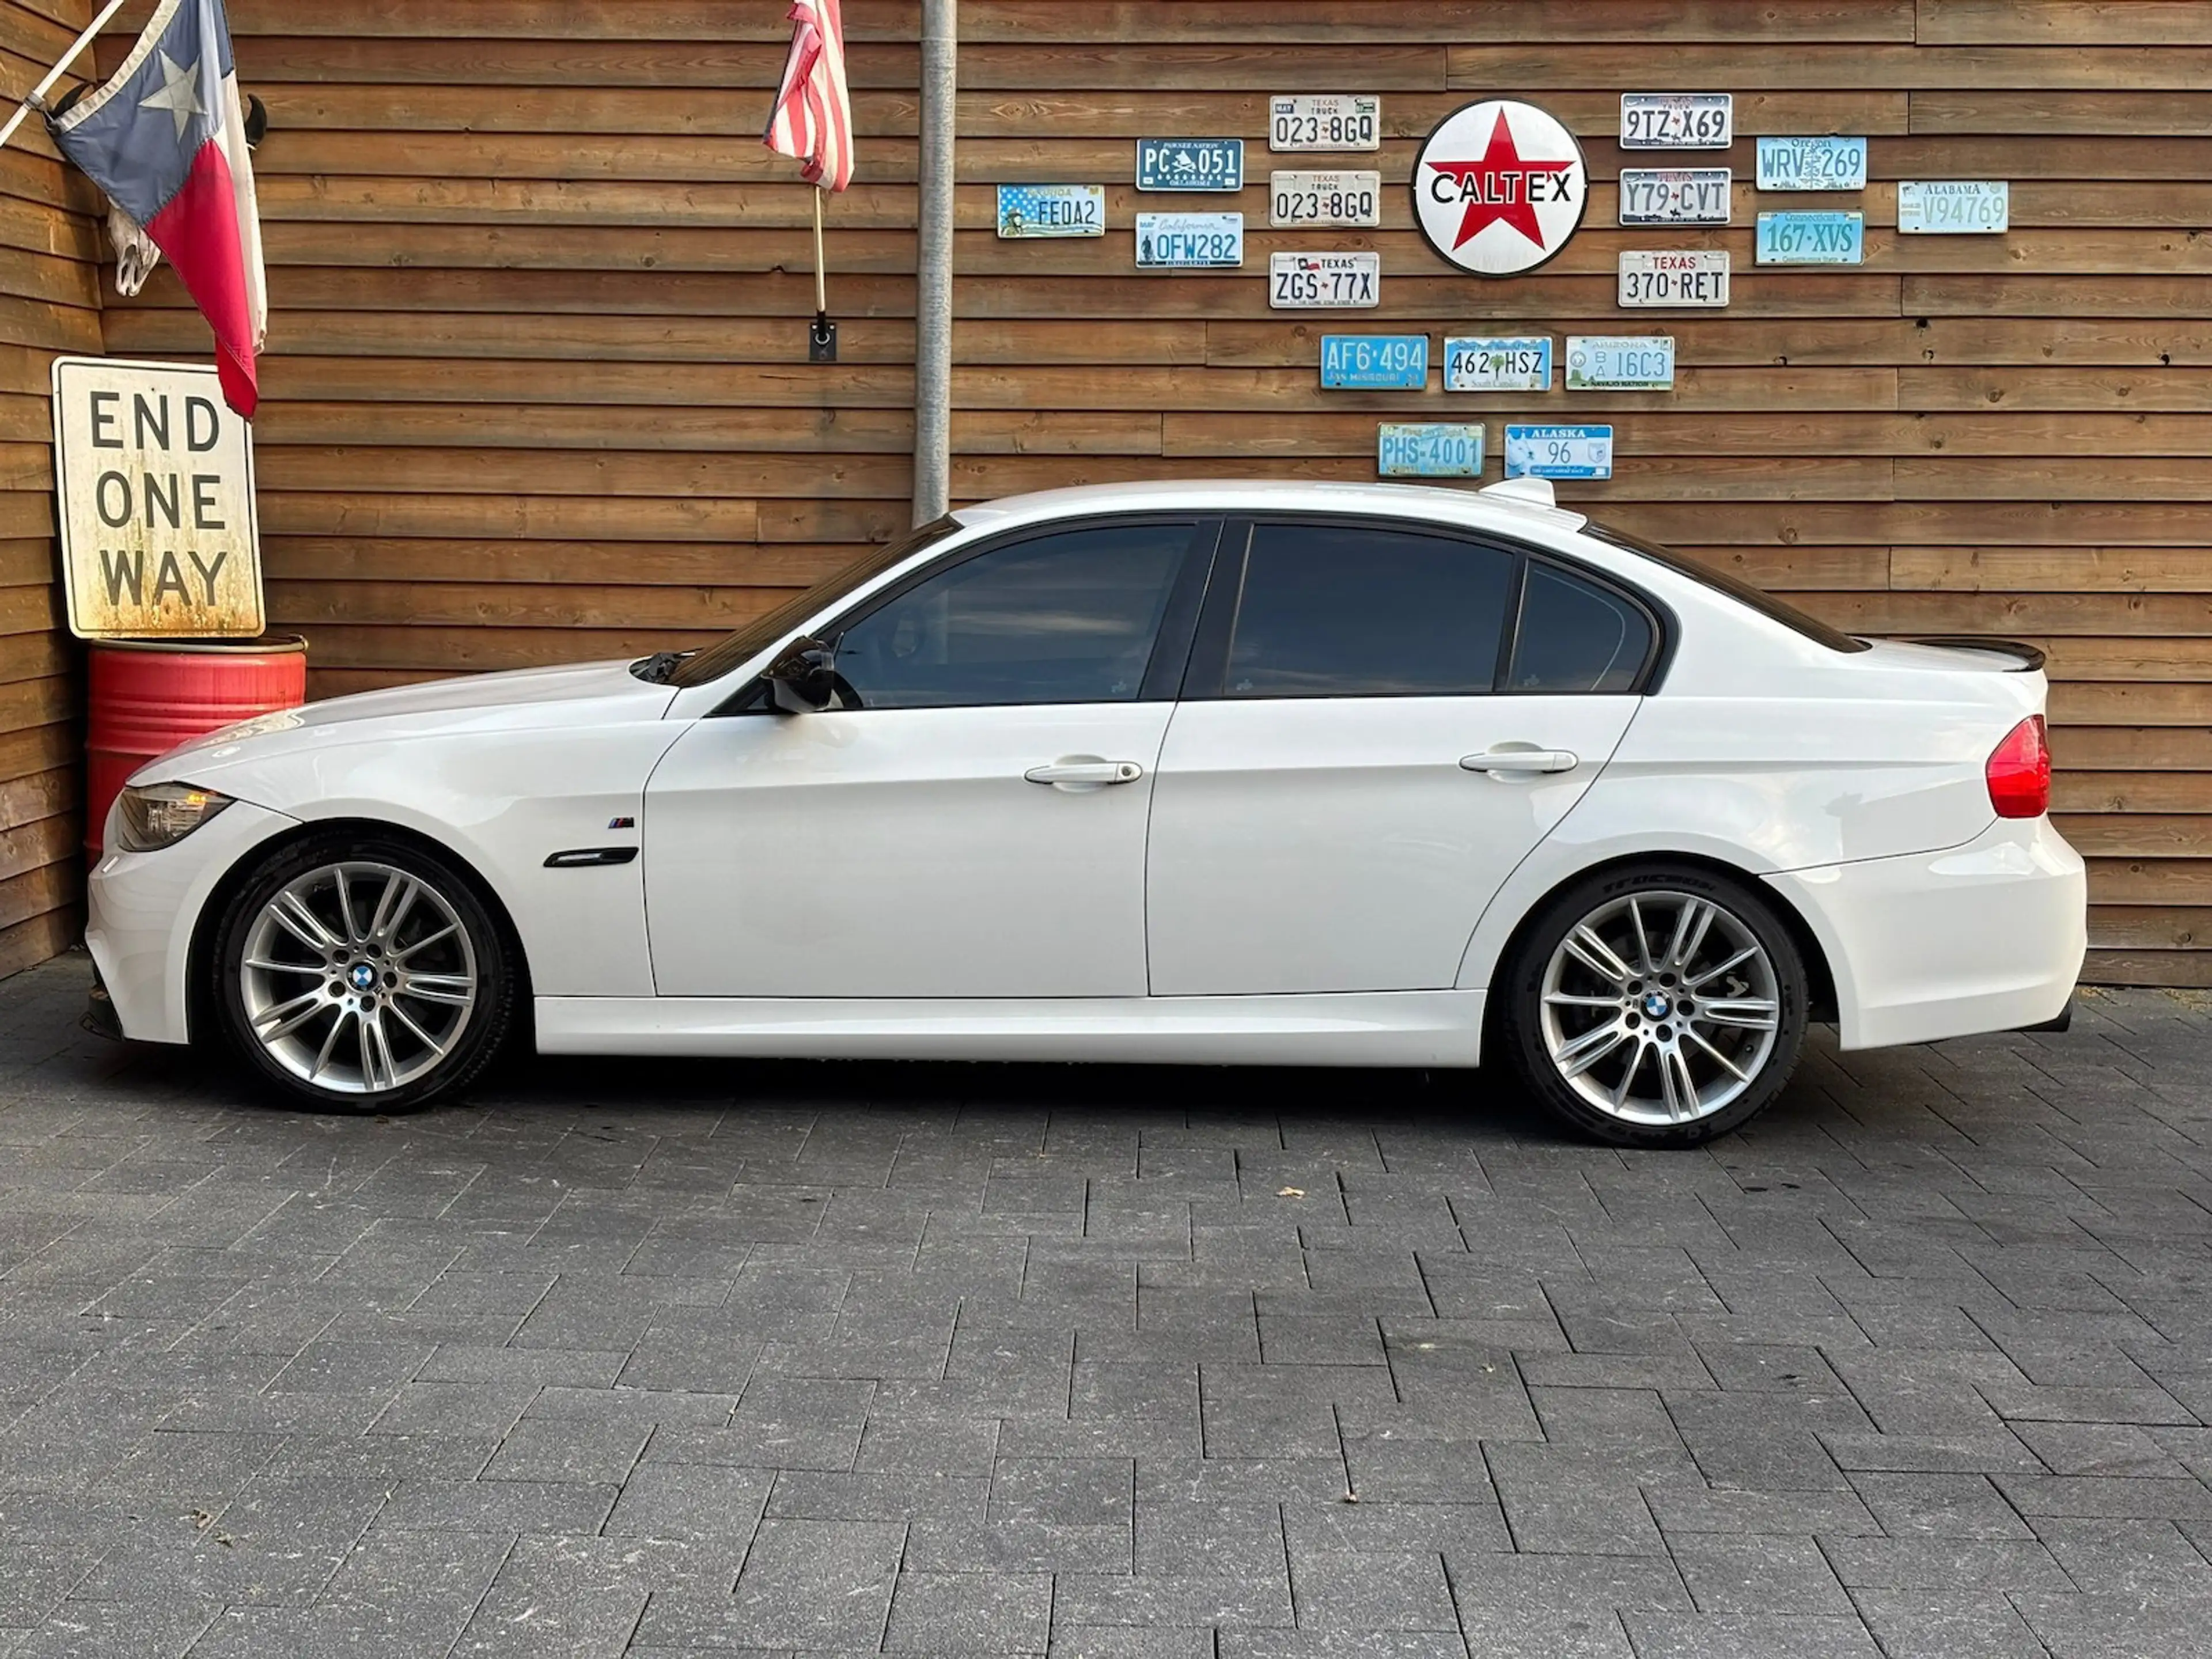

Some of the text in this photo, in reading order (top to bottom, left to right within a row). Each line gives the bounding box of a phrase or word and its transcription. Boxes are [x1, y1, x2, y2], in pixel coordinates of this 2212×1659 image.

[1277, 116, 1372, 142] 023 8GQ
[1627, 110, 1724, 137] 9TZ X69
[1145, 148, 1237, 173] PC 051
[1762, 148, 1860, 177] WRV 269
[1431, 172, 1571, 204] CALTEX
[1681, 182, 1725, 210] CVT
[1925, 184, 1980, 194] ALABAMA
[1277, 191, 1373, 218] 023 8GQ
[1923, 196, 2004, 224] V94769
[1158, 218, 1220, 232] California
[1321, 258, 1354, 269] TEXAS
[1653, 257, 1696, 269] TEXAS
[1277, 272, 1371, 300] ZGS 77X
[1627, 272, 1724, 299] 370 RET
[1451, 352, 1543, 374] 462 HSZ
[90, 391, 219, 452] END
[1531, 429, 1586, 438] ALASKA
[1548, 441, 1571, 464] 96
[96, 470, 225, 530] ONE
[99, 550, 228, 607] WAY
